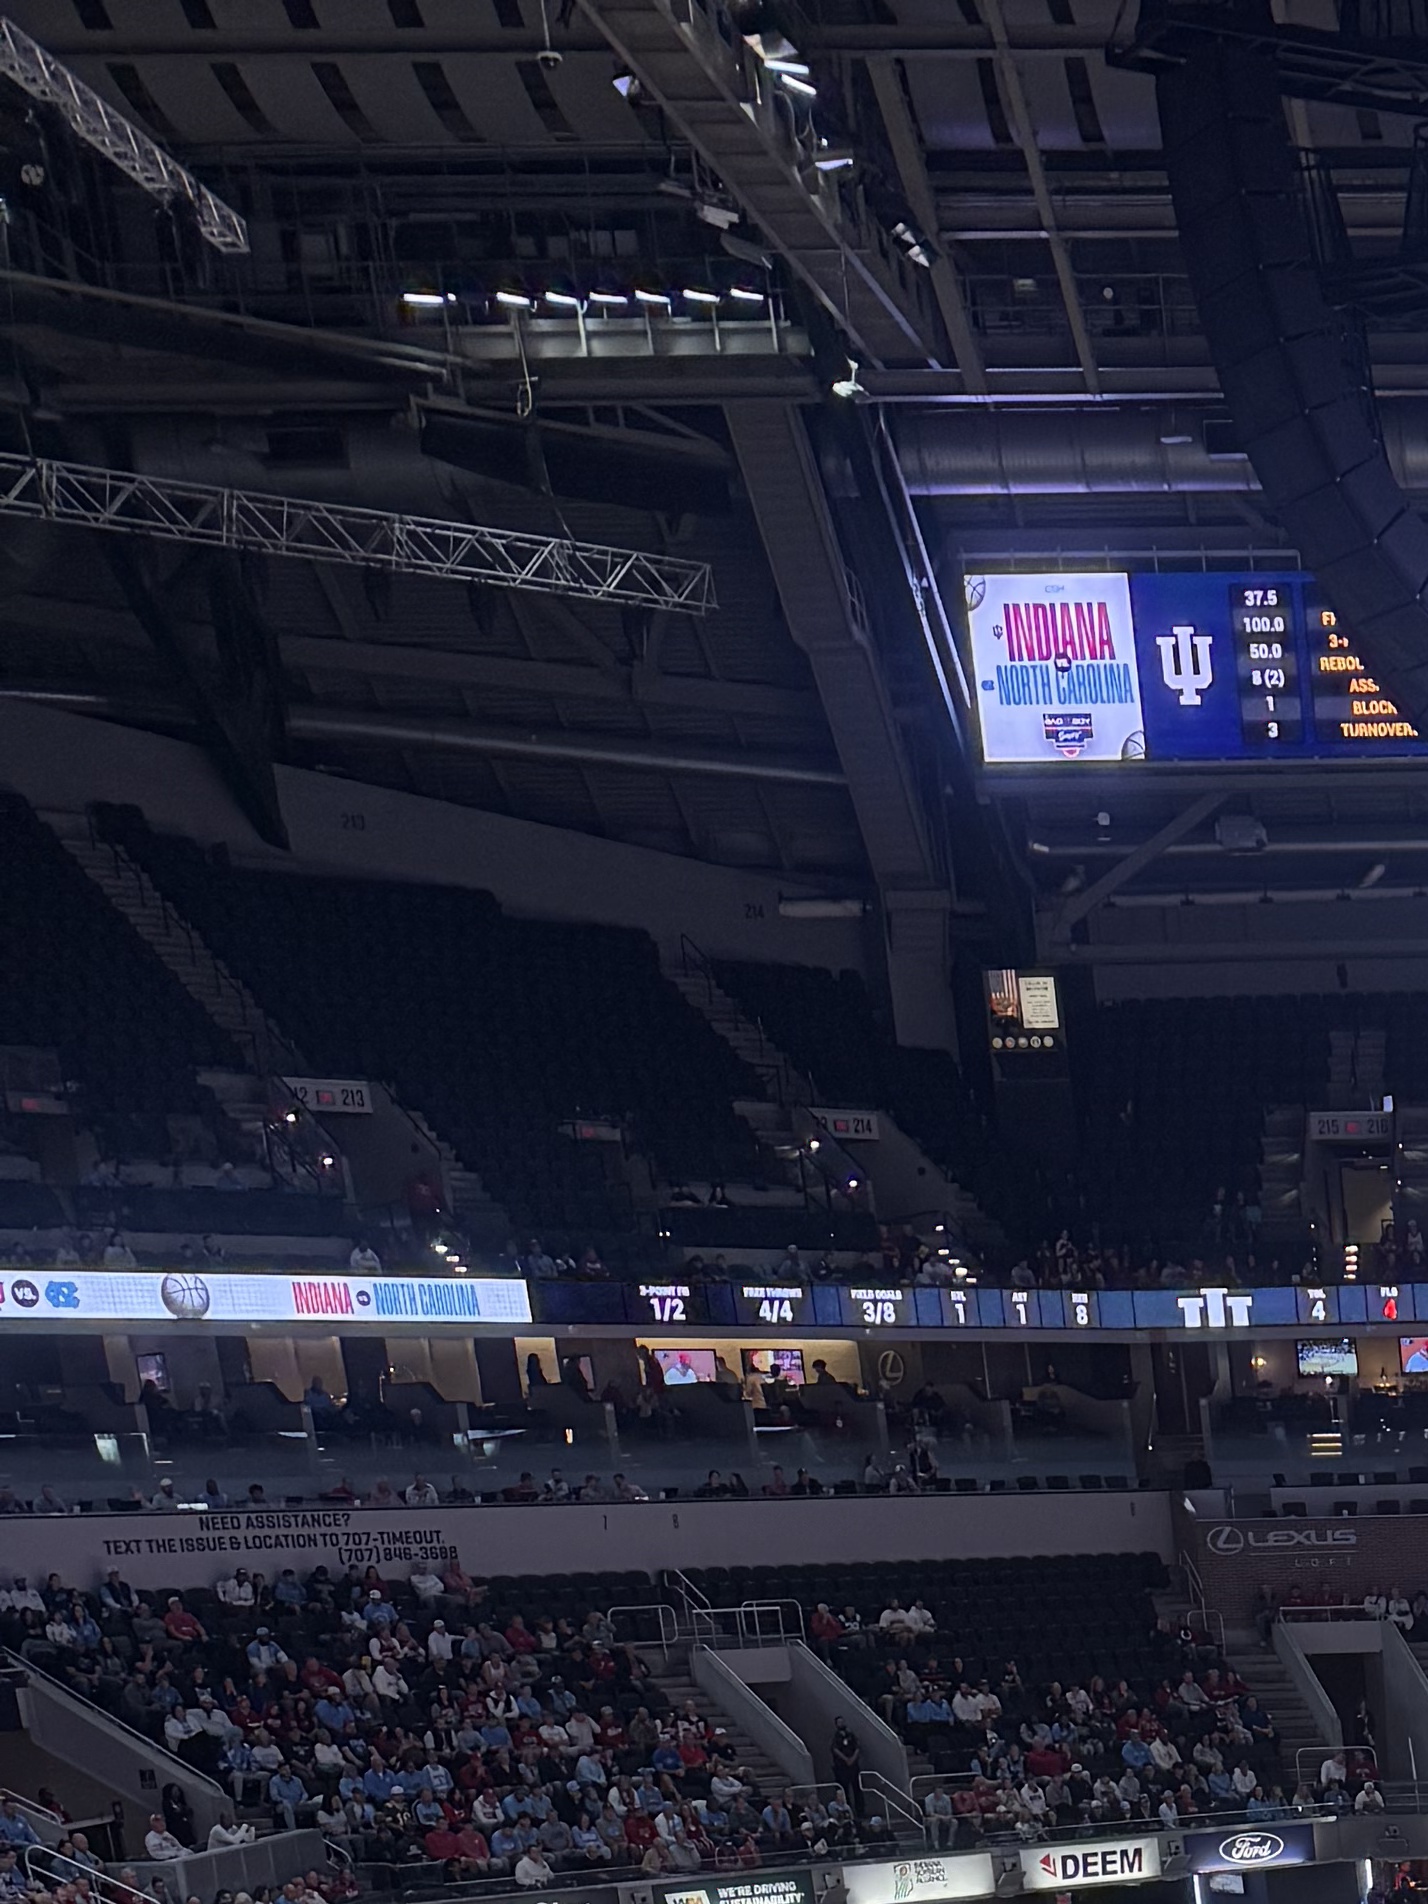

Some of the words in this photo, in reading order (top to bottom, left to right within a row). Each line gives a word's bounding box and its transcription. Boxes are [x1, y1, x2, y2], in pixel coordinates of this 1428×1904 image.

[1244, 590, 1277, 606] 37.5
[1003, 602, 1116, 662] INDIANA
[1243, 617, 1284, 632] 100.0
[1250, 644, 1282, 659] 50.0
[996, 664, 1053, 706] NORTH
[1056, 663, 1135, 705] CAROLINA
[1264, 669, 1285, 688] (2)
[1266, 697, 1275, 711] 1
[1268, 722, 1279, 738] 3
[291, 1281, 353, 1315] INDIANA
[373, 1282, 418, 1316] NORTH
[419, 1282, 480, 1316] CAROLINA
[650, 1299, 687, 1322] 1/2
[759, 1300, 793, 1322] 4/4
[863, 1300, 896, 1323] 3/8
[954, 1303, 965, 1323] 1
[1016, 1303, 1026, 1324] 1
[1075, 1304, 1089, 1325] 8
[1311, 1301, 1325, 1321] 4
[199, 1514, 241, 1532] NEED
[245, 1511, 351, 1531] ASSISTANCE?
[103, 1538, 142, 1556] TEXT
[145, 1537, 177, 1554] THE
[179, 1535, 226, 1553] ISSUE
[245, 1532, 317, 1550] LOCATION
[320, 1531, 339, 1547] TO
[341, 1528, 445, 1547] 707-TIMEOUT.
[1248, 1529, 1357, 1546] LEXUS
[338, 1545, 381, 1566] (707)
[1231, 1836, 1271, 1859] Ford
[1061, 1847, 1144, 1881] DEEM
[753, 1882, 798, 1897] DRIVING
